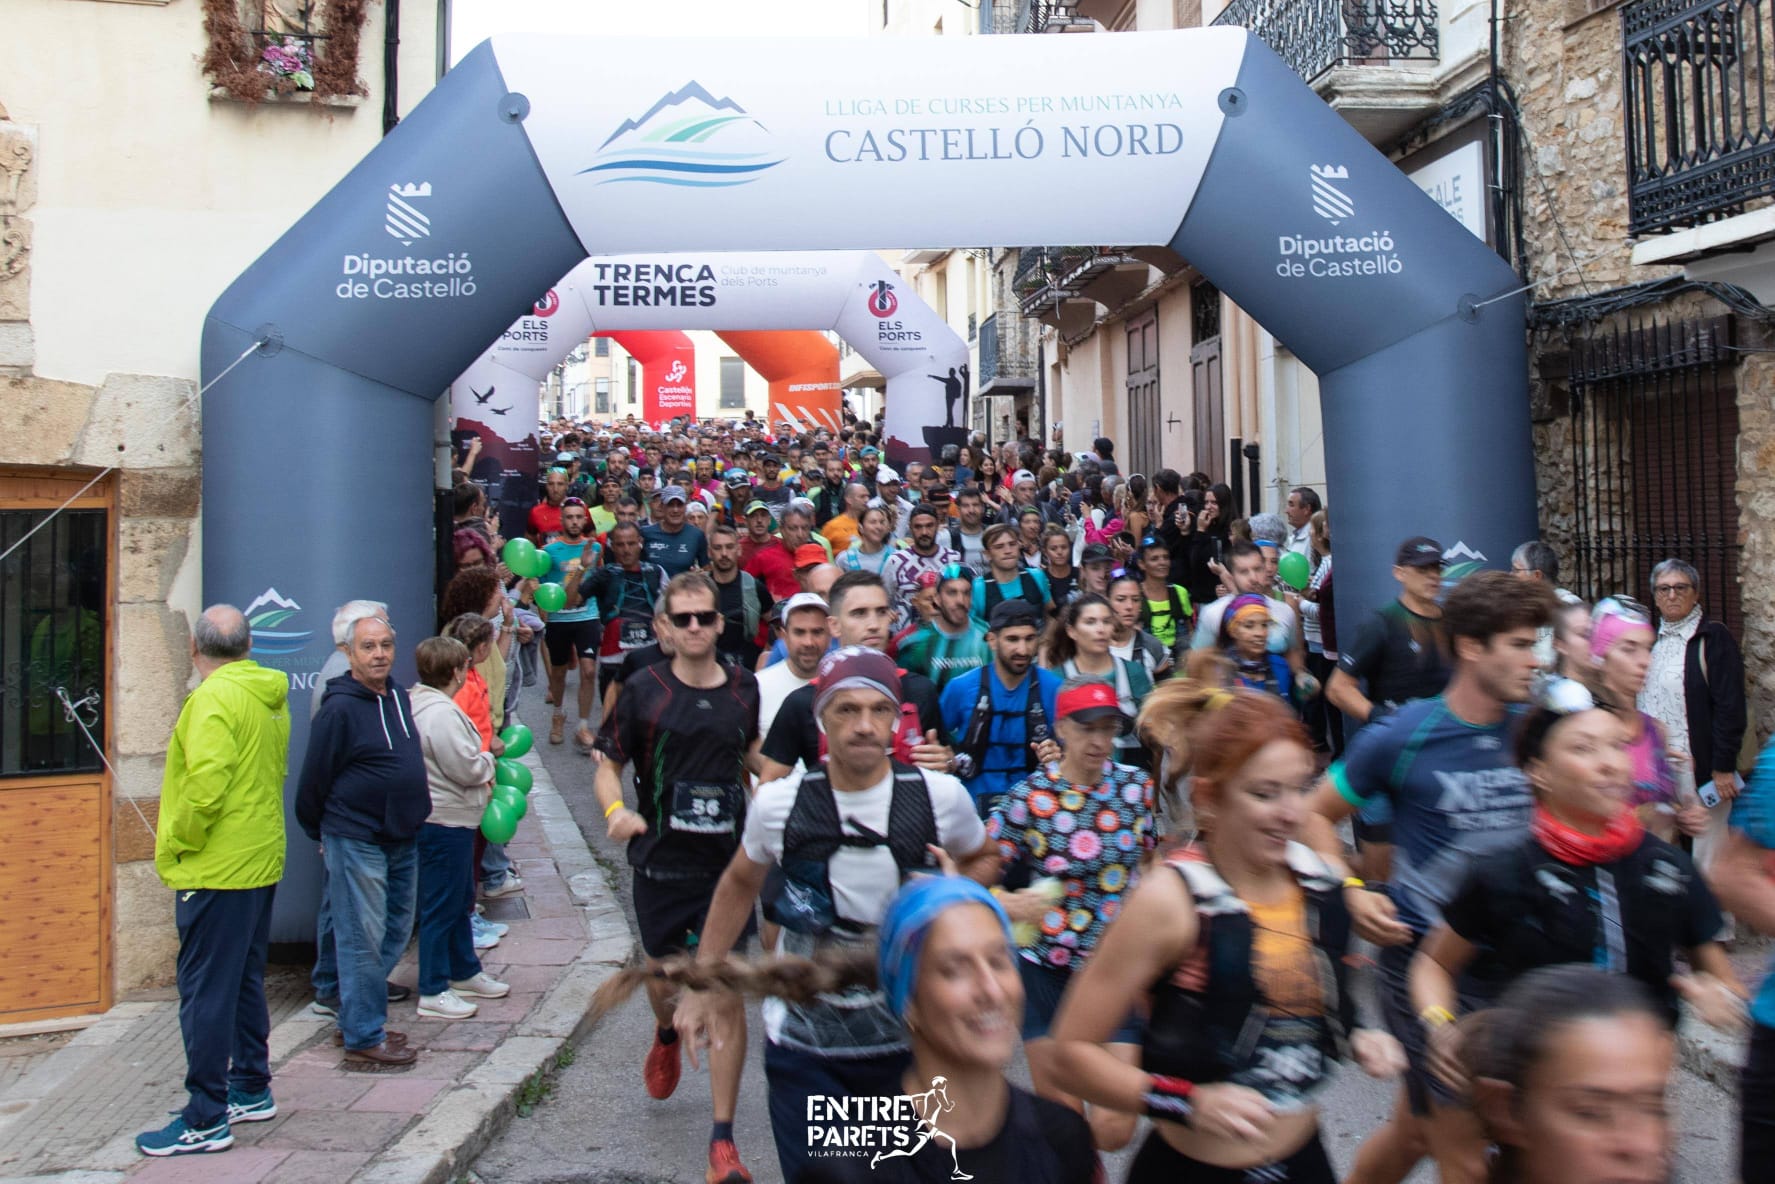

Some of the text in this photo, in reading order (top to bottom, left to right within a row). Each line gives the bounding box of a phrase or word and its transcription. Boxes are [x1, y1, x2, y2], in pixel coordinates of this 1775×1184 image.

[825, 93, 1183, 116] LLIGA DE CURSES PER MUNTANYA
[825, 118, 1184, 163] CASTELLÓ NORD
[1279, 230, 1394, 259] Diputació
[343, 252, 472, 279] Diputació
[594, 263, 718, 283] TRENCA
[720, 265, 827, 278] Club de muntanya
[1276, 253, 1403, 277] de Castelló
[335, 276, 477, 299] de Castelló
[720, 276, 778, 287] dels Ports
[593, 285, 717, 307] TERMES
[523, 320, 548, 330] ELS
[878, 321, 903, 330] ELS
[503, 331, 548, 341] PORTS
[878, 331, 922, 341] PORTS
